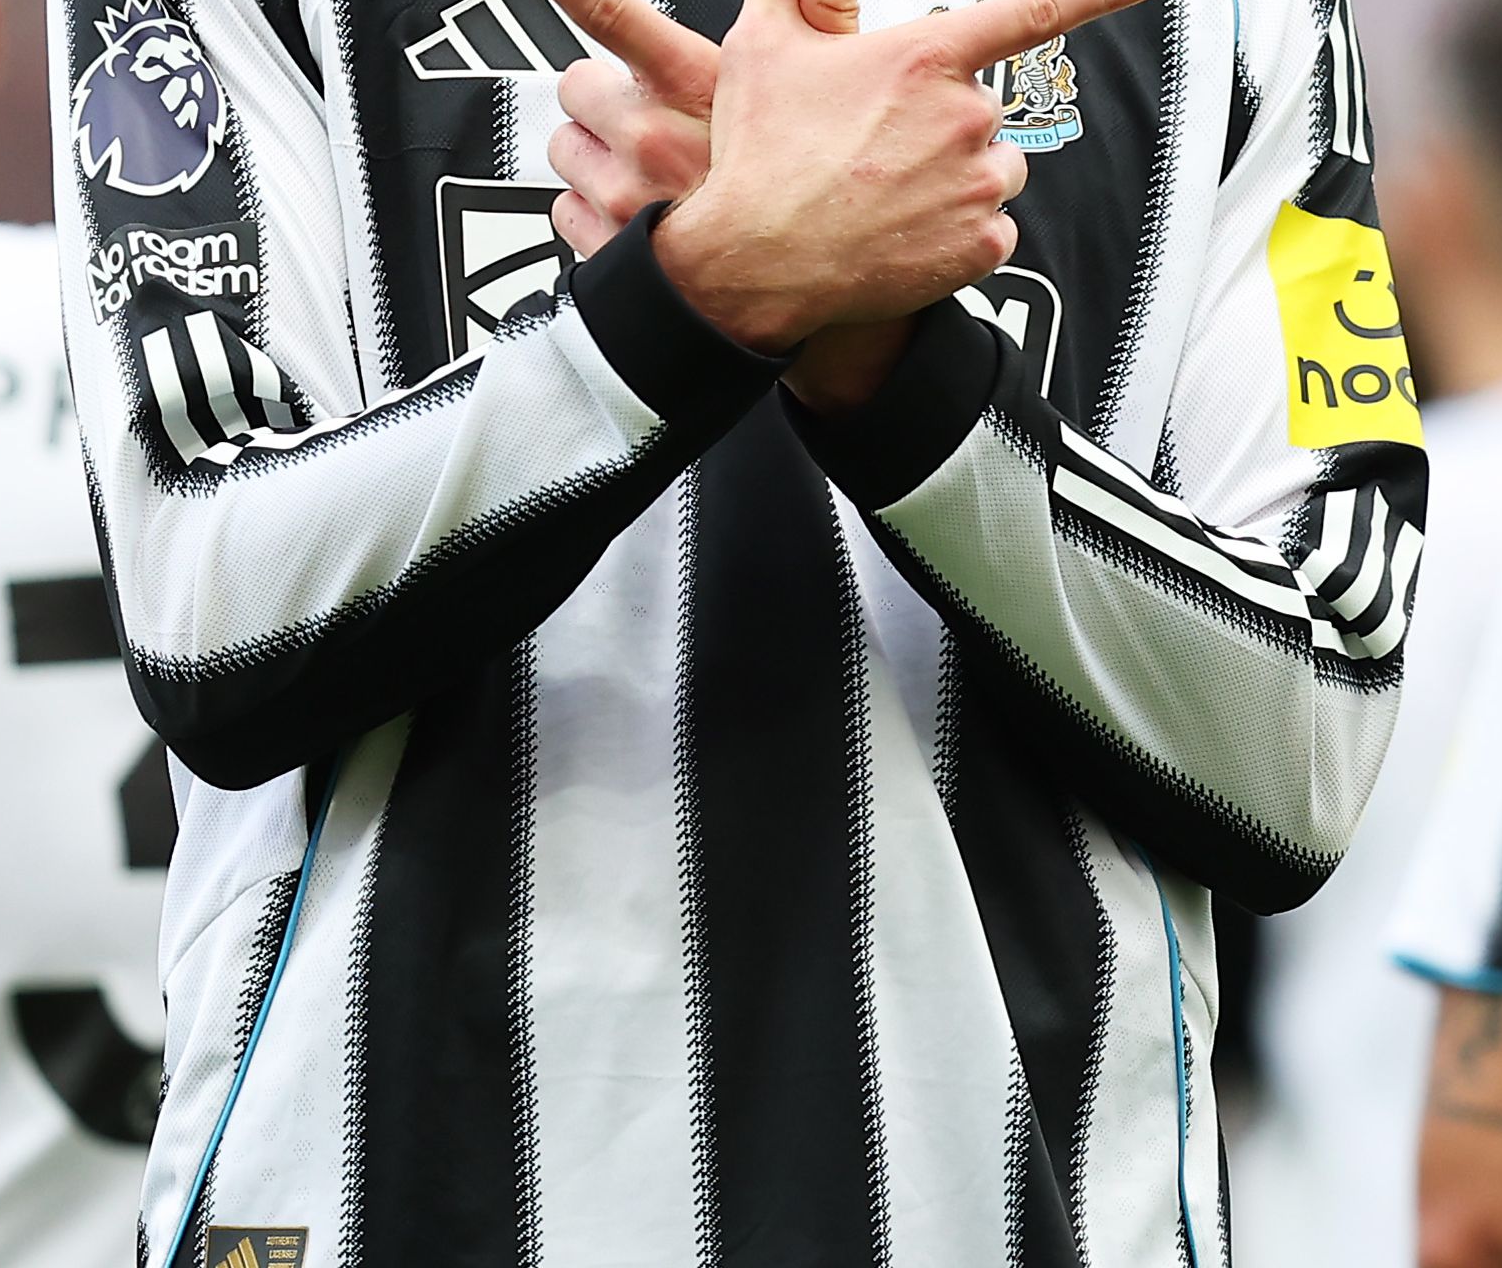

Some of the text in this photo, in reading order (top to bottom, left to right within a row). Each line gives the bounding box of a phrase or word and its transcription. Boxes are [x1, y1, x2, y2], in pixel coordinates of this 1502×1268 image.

[87, 231, 238, 296] No room
[131, 255, 258, 296] racism
